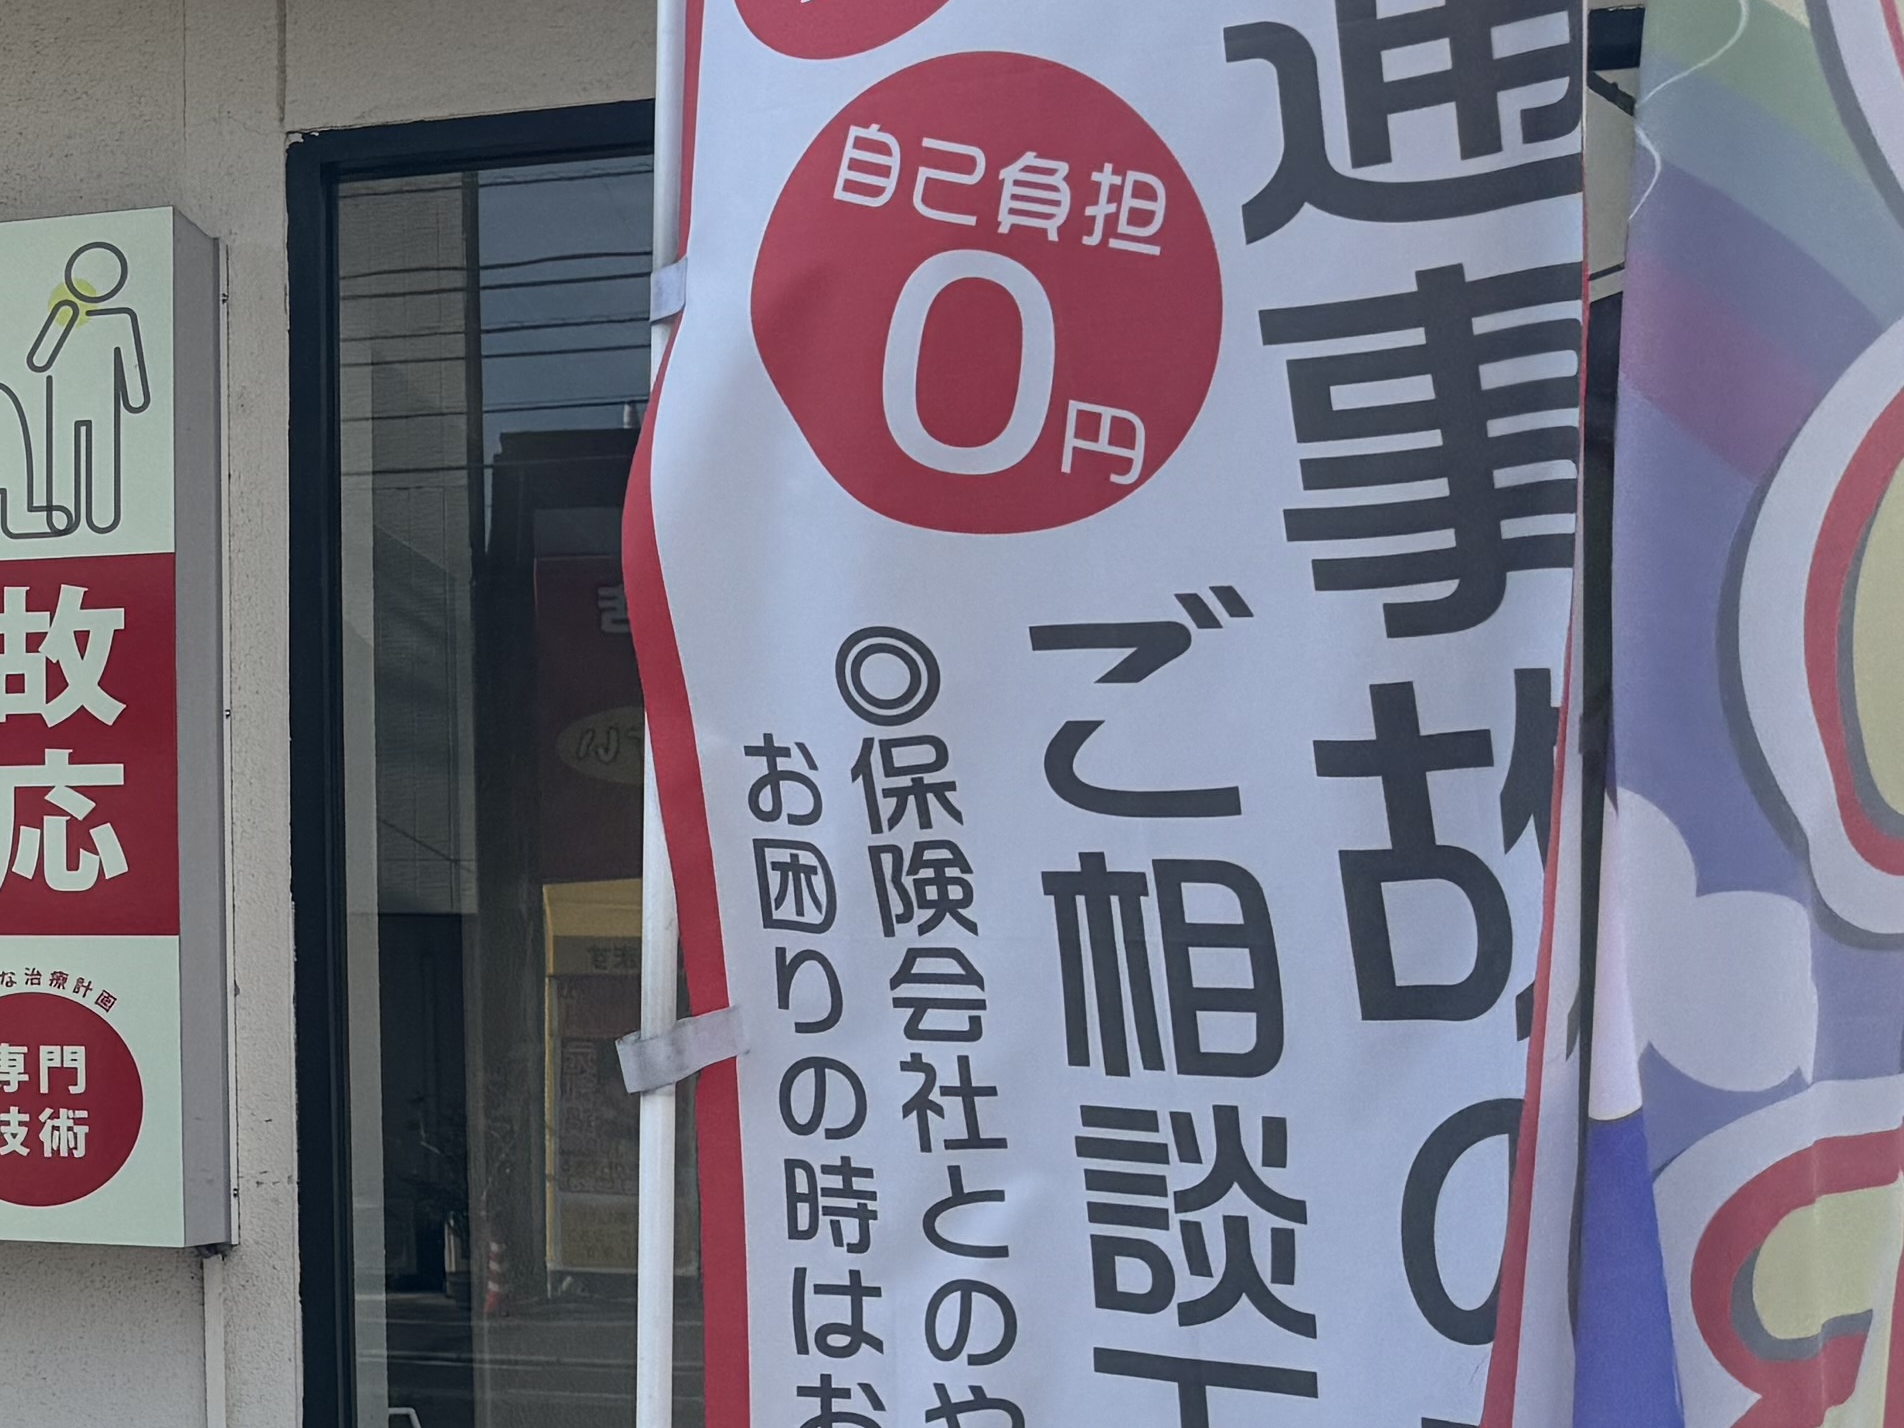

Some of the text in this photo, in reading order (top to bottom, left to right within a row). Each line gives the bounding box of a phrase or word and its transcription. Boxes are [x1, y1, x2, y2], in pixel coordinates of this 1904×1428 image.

[832, 122, 1170, 256] 自己負担
[880, 248, 1148, 486] 0円
